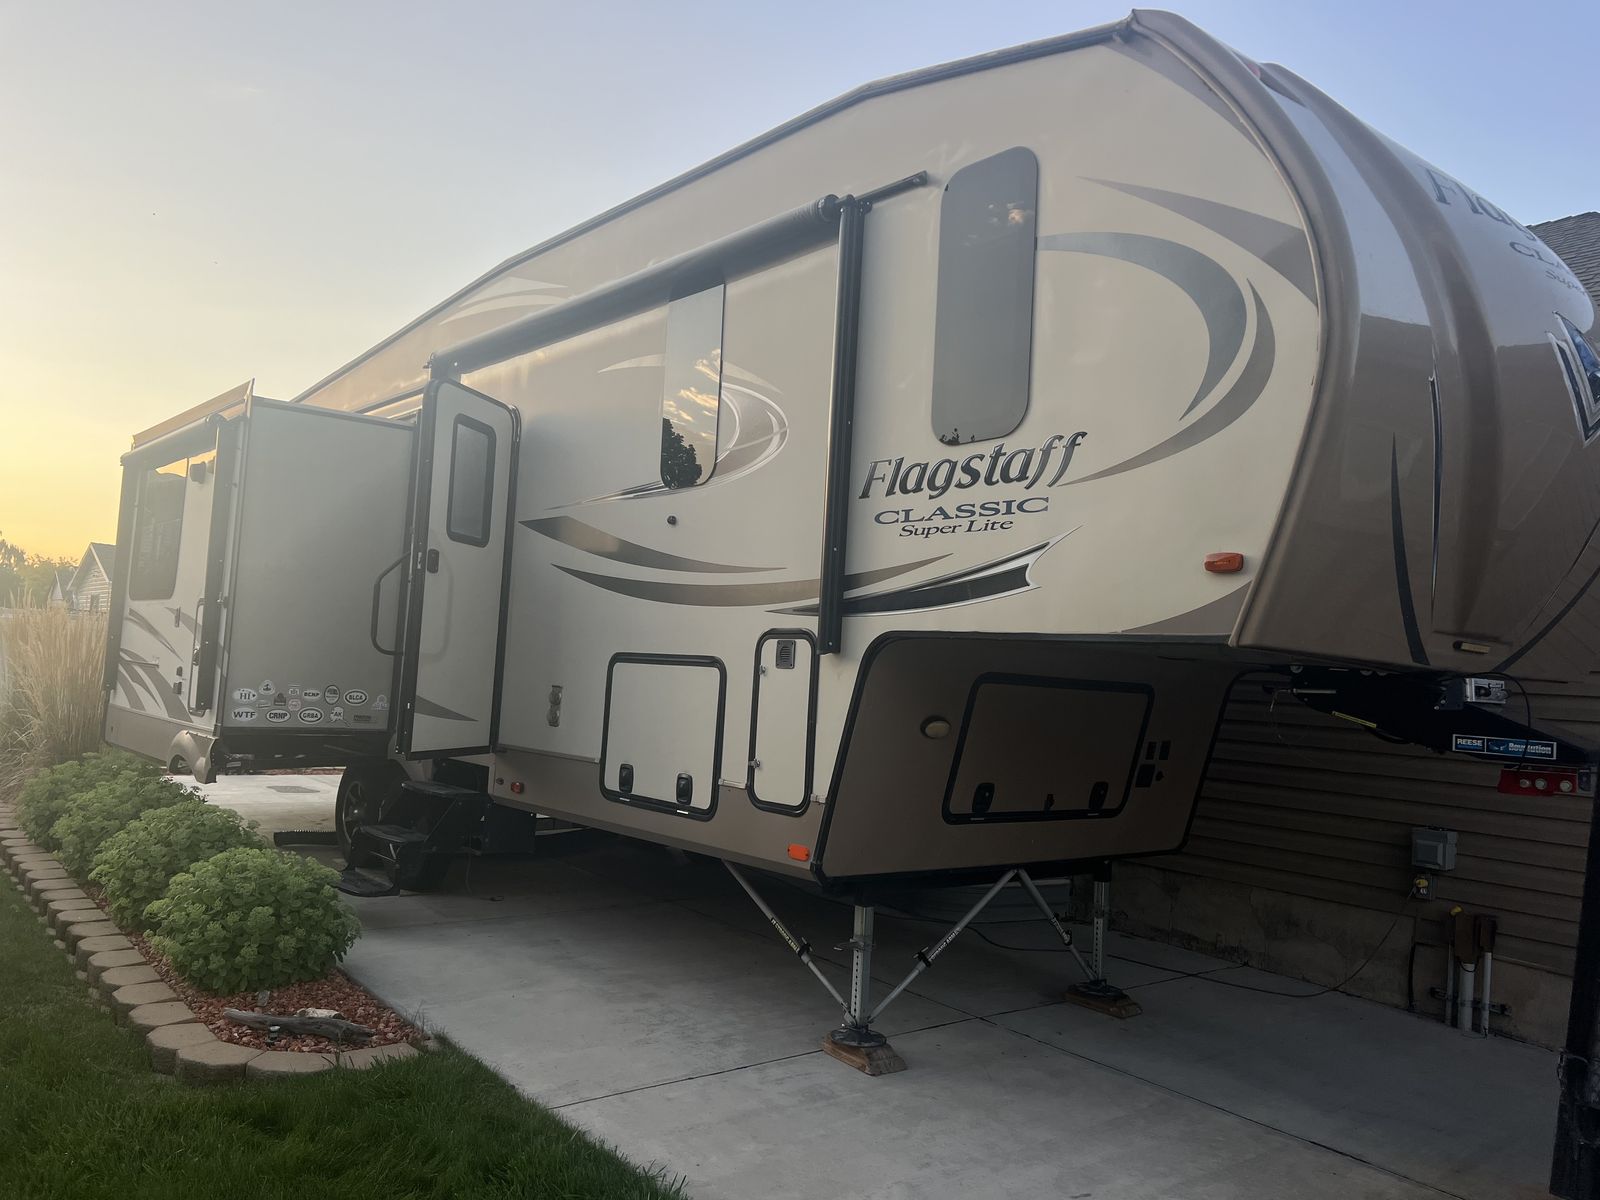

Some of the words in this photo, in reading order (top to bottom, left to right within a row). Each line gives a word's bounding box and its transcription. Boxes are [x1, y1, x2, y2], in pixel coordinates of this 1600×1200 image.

[858, 431, 1088, 500] Flagstaff
[874, 497, 1049, 524] CLASSIC
[899, 523, 962, 539] Super
[964, 519, 1014, 533] Lite
[239, 692, 251, 700] HI
[1457, 738, 1483, 747] REESE
